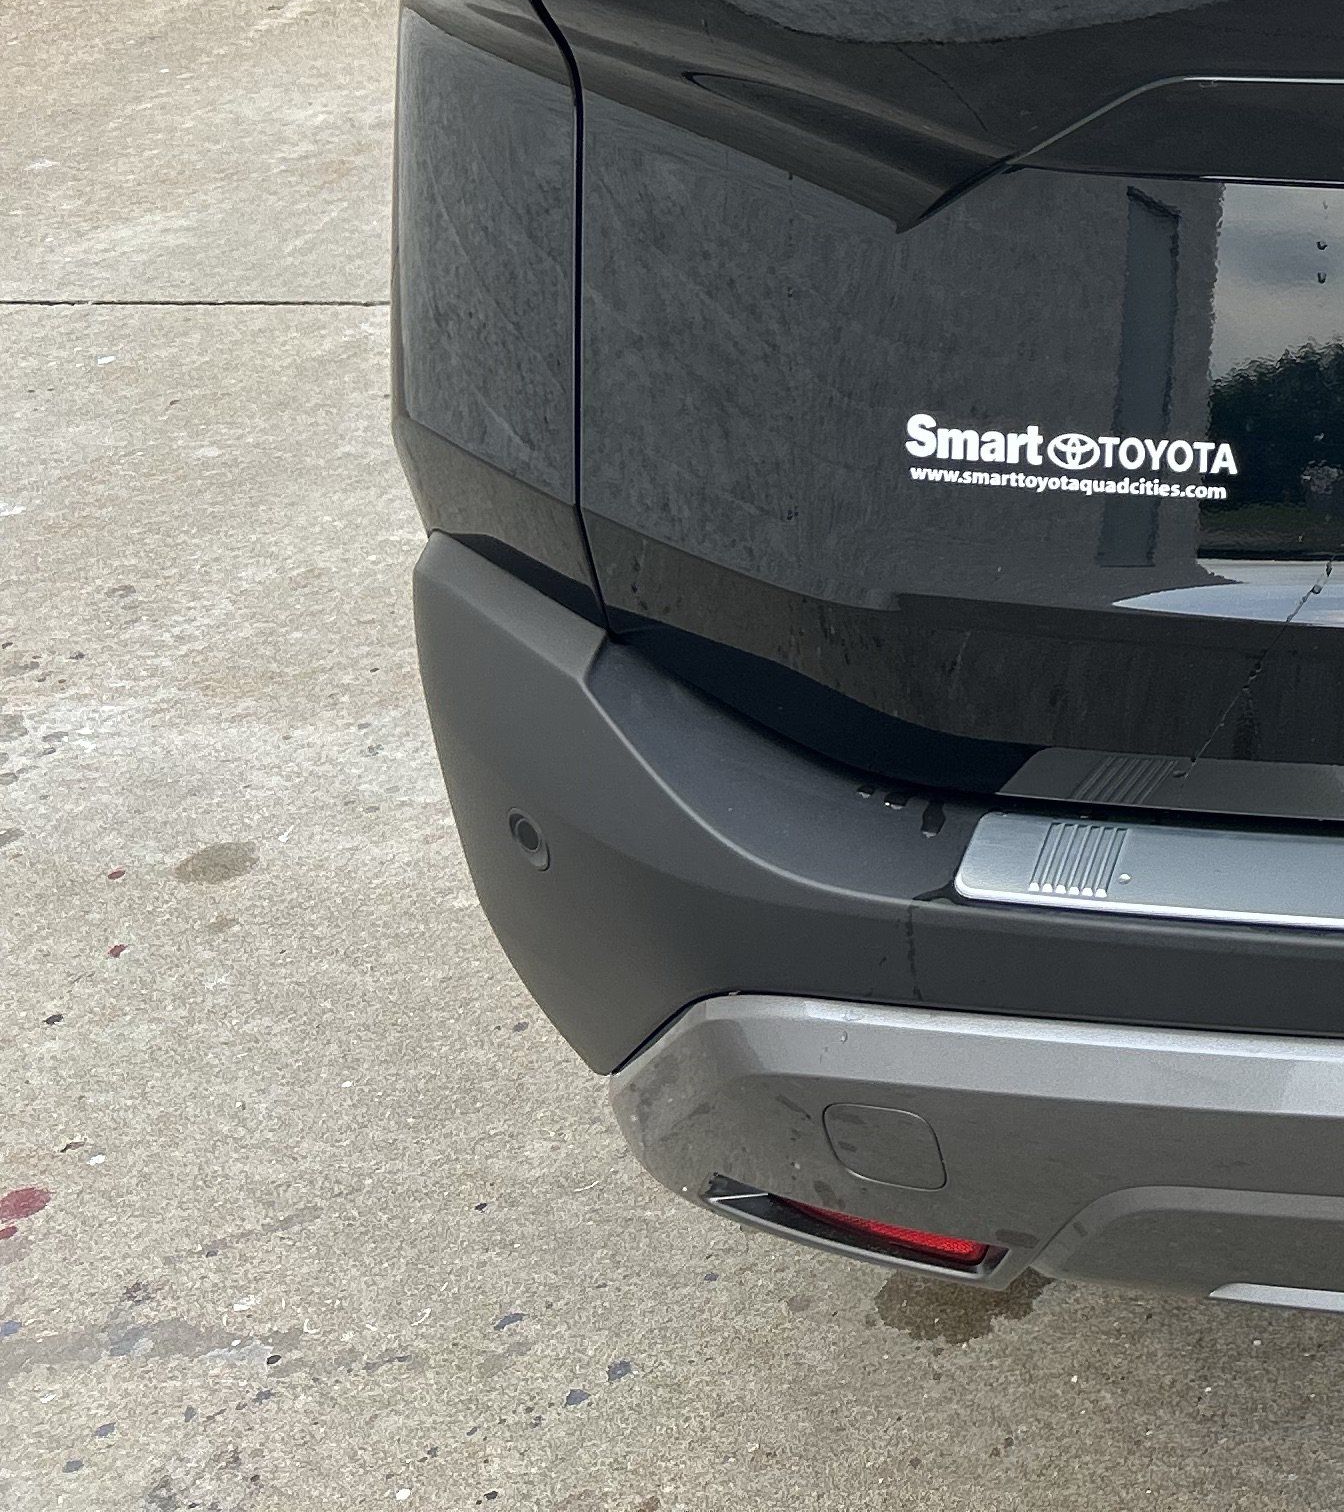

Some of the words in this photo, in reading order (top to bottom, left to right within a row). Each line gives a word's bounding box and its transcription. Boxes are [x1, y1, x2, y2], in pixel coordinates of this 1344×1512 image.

[905, 413, 1043, 465] Smart
[1098, 436, 1238, 475] TOYOTA
[909, 465, 1227, 500] www.smarttoyotaquadcities.com
